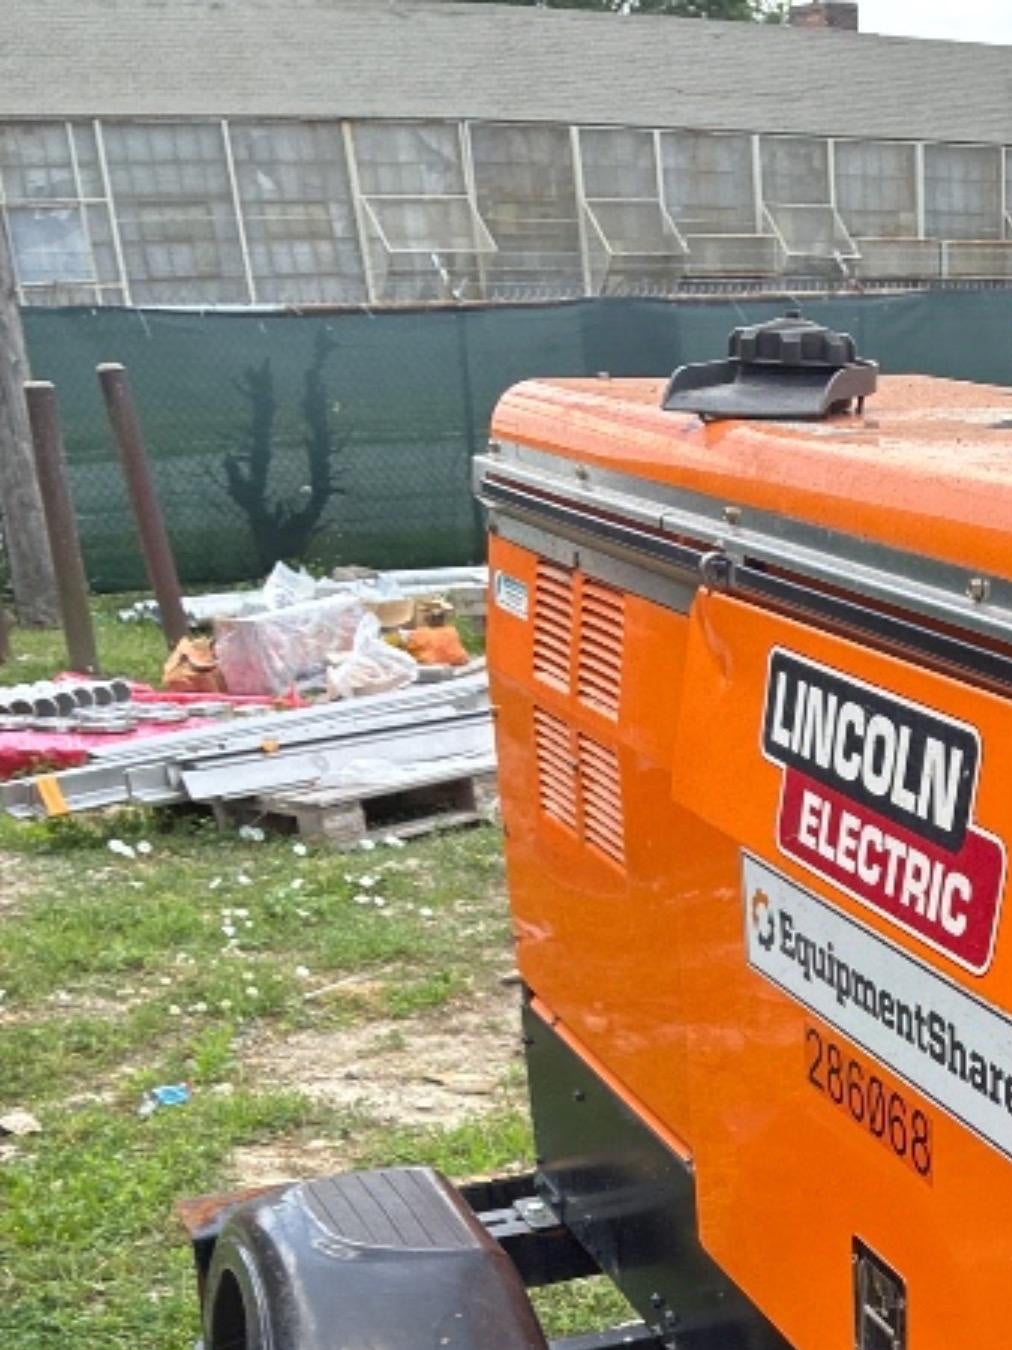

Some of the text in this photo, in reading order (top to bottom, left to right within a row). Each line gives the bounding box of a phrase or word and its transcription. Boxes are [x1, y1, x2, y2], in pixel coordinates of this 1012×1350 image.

[771, 671, 962, 832] LINCOLN
[799, 789, 973, 938] ELECTRIC
[805, 1027, 932, 1177] 286068
